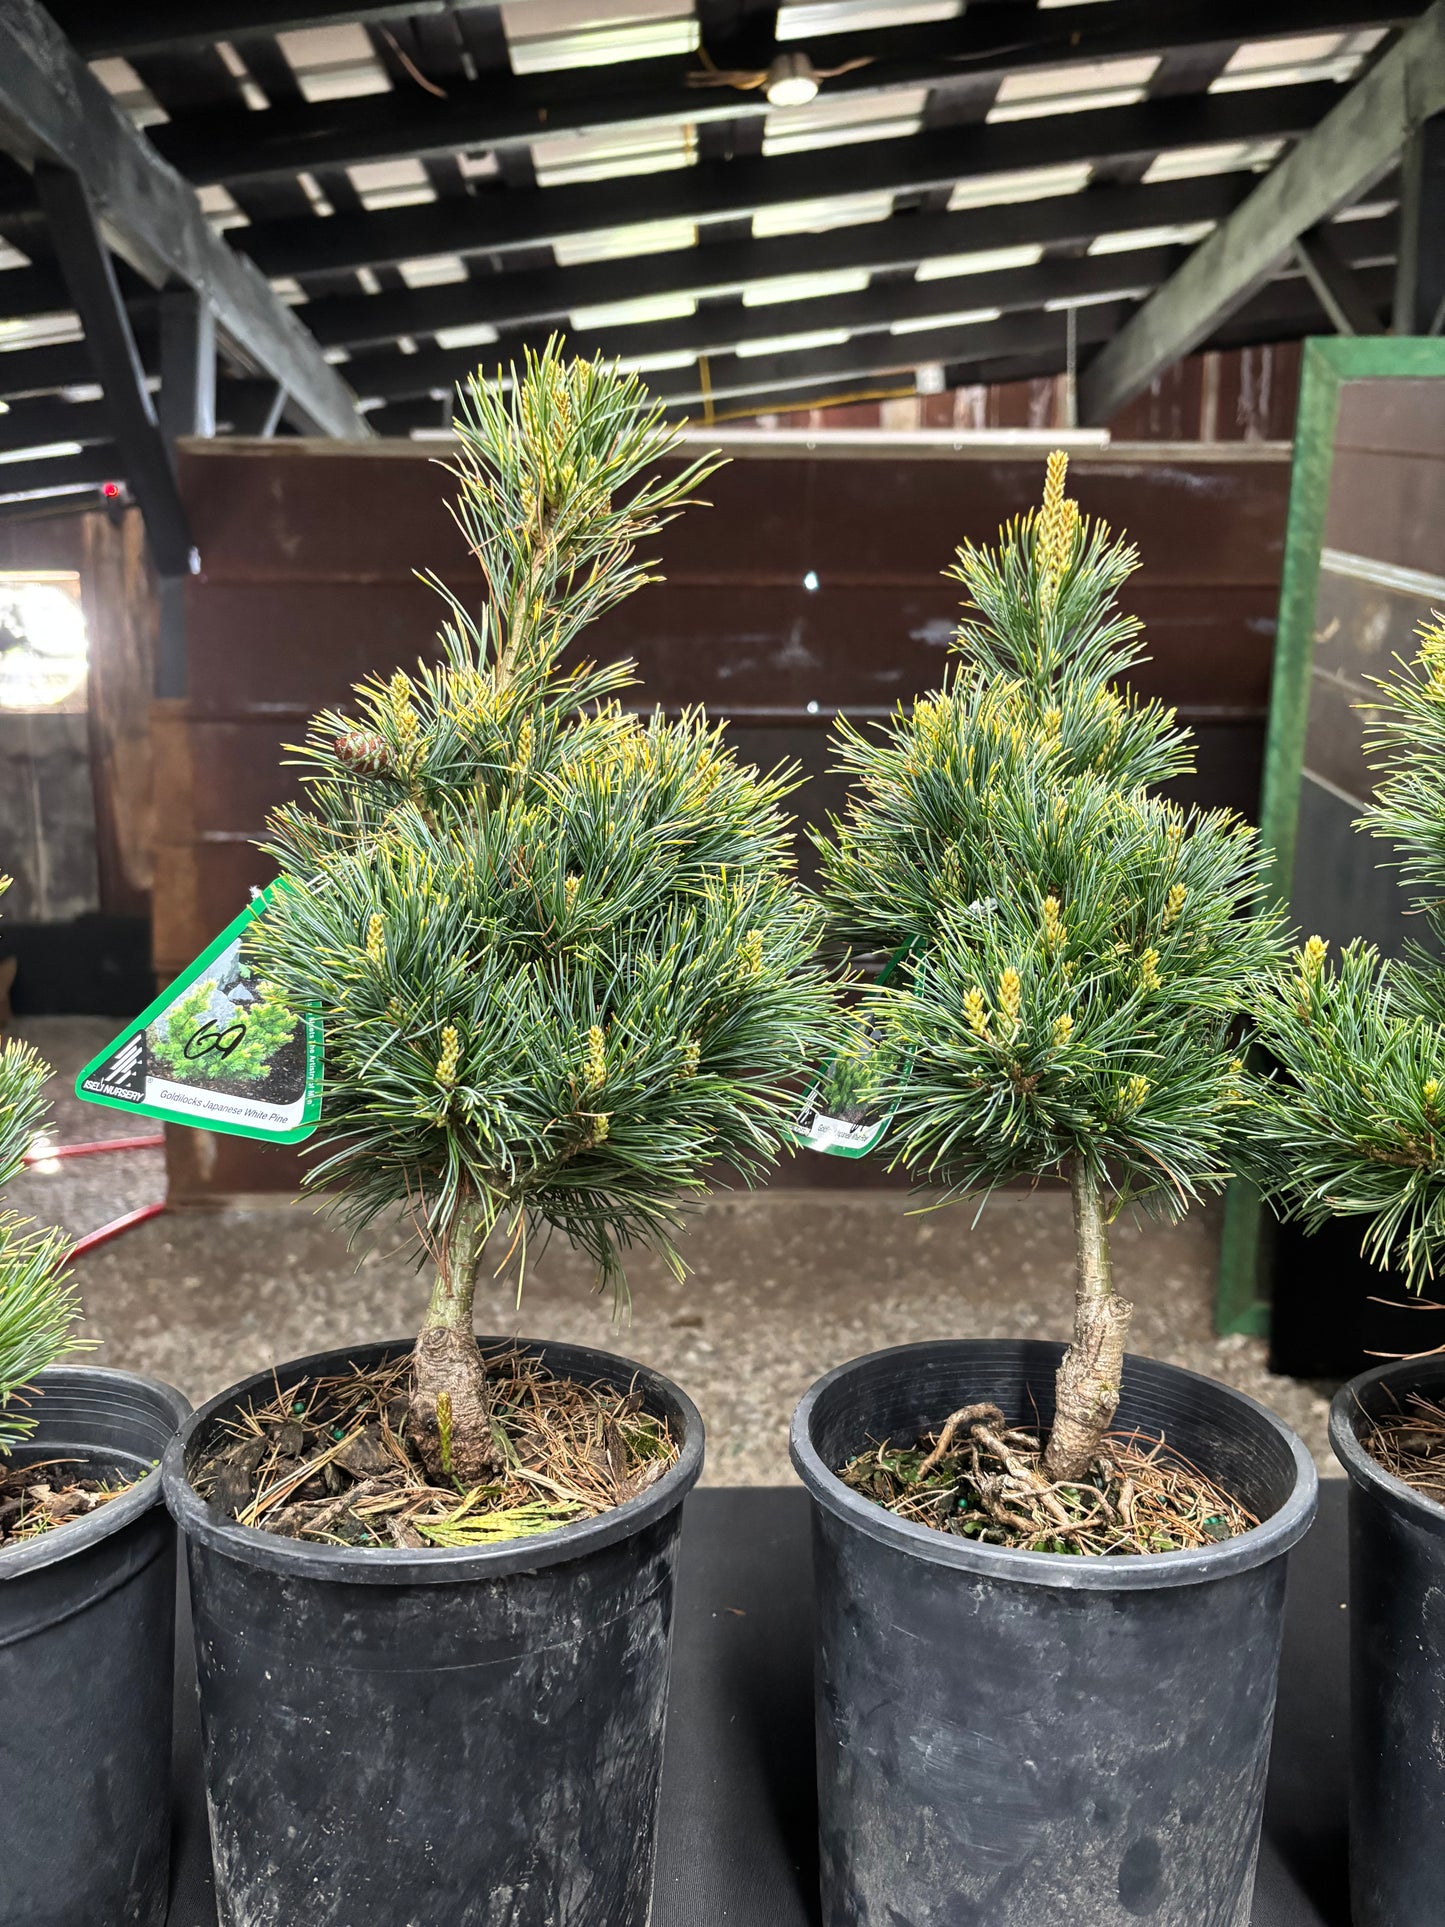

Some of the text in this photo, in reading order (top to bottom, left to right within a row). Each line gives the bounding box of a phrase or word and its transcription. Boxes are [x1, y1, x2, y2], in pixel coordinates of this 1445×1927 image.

[83, 1078, 145, 1102] ISELI NURSERY
[307, 1090, 315, 1105] Mn
[160, 1090, 289, 1124] Goldilocks Japanese White Pine
